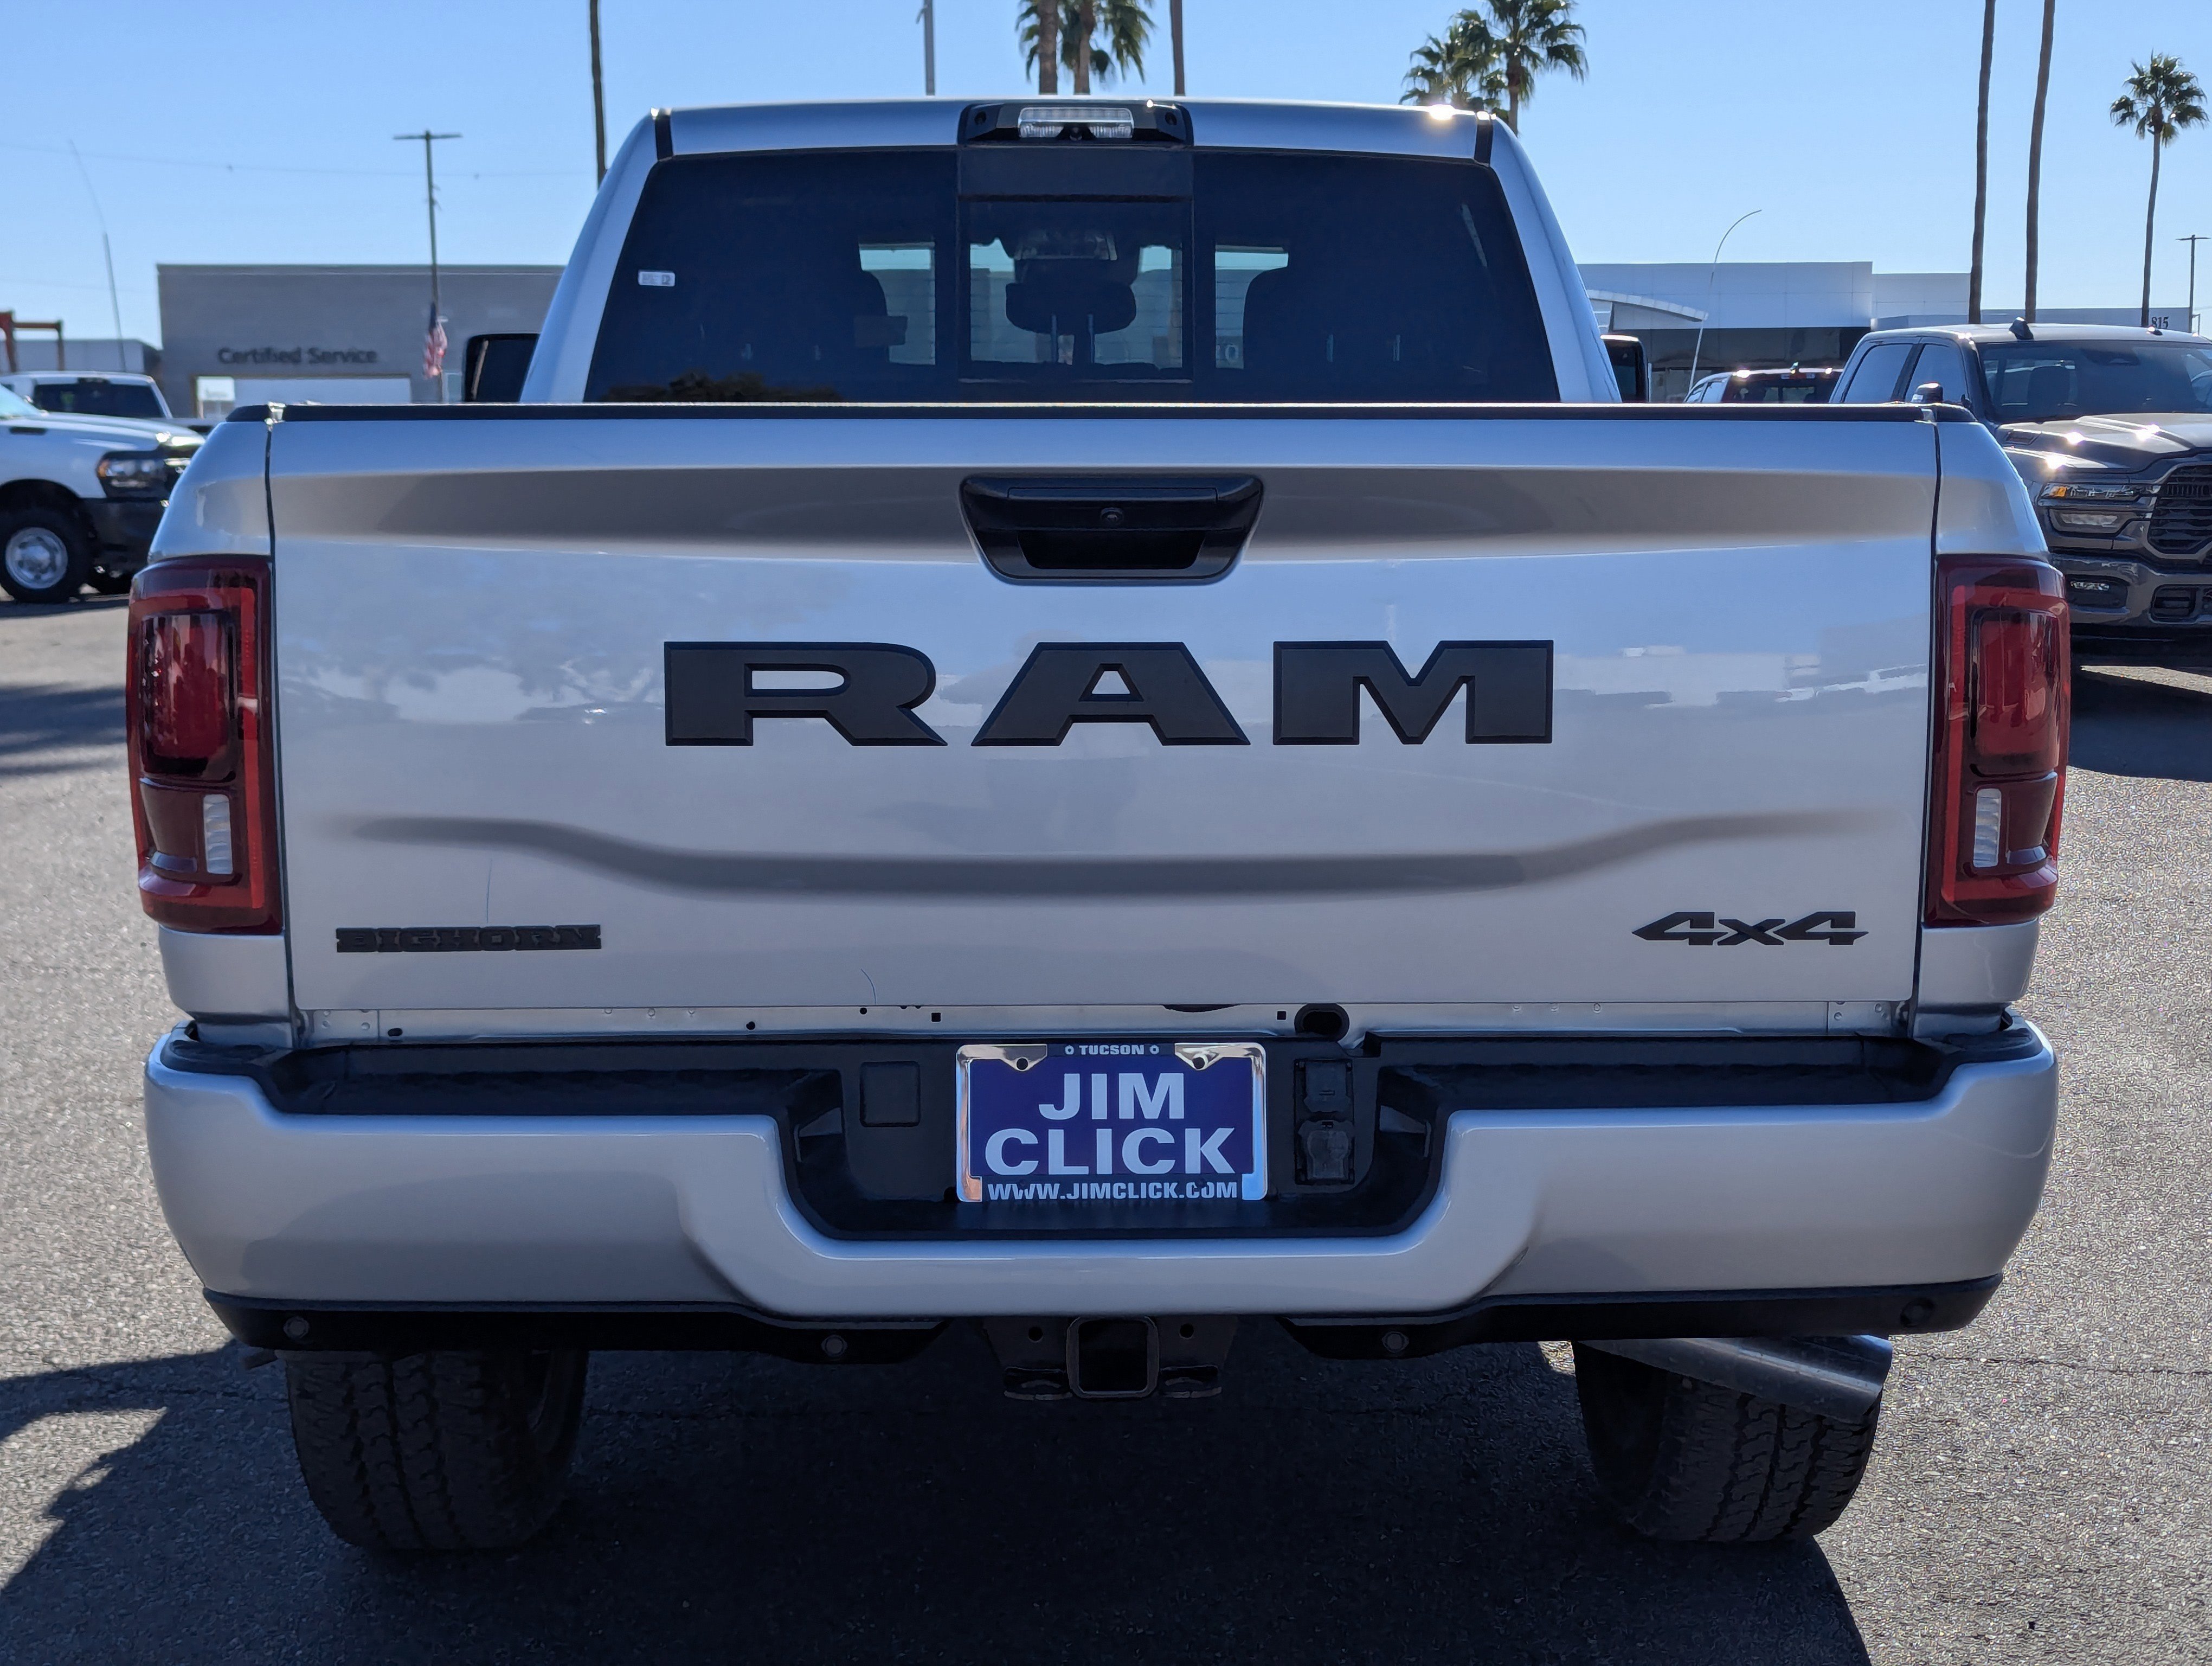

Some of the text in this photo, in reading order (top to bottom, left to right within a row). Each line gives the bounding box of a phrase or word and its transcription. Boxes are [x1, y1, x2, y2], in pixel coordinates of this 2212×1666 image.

[2151, 316, 2169, 329] 815
[218, 347, 377, 364] Certified Service
[664, 640, 1554, 747] RAM
[336, 924, 602, 952] BIGHORN
[1079, 1045, 1144, 1055] TUCSON
[1038, 1072, 1185, 1120] JIM
[985, 1127, 1236, 1175] CLICK
[987, 1182, 1238, 1200] WWW.JIMCLICK.COM
